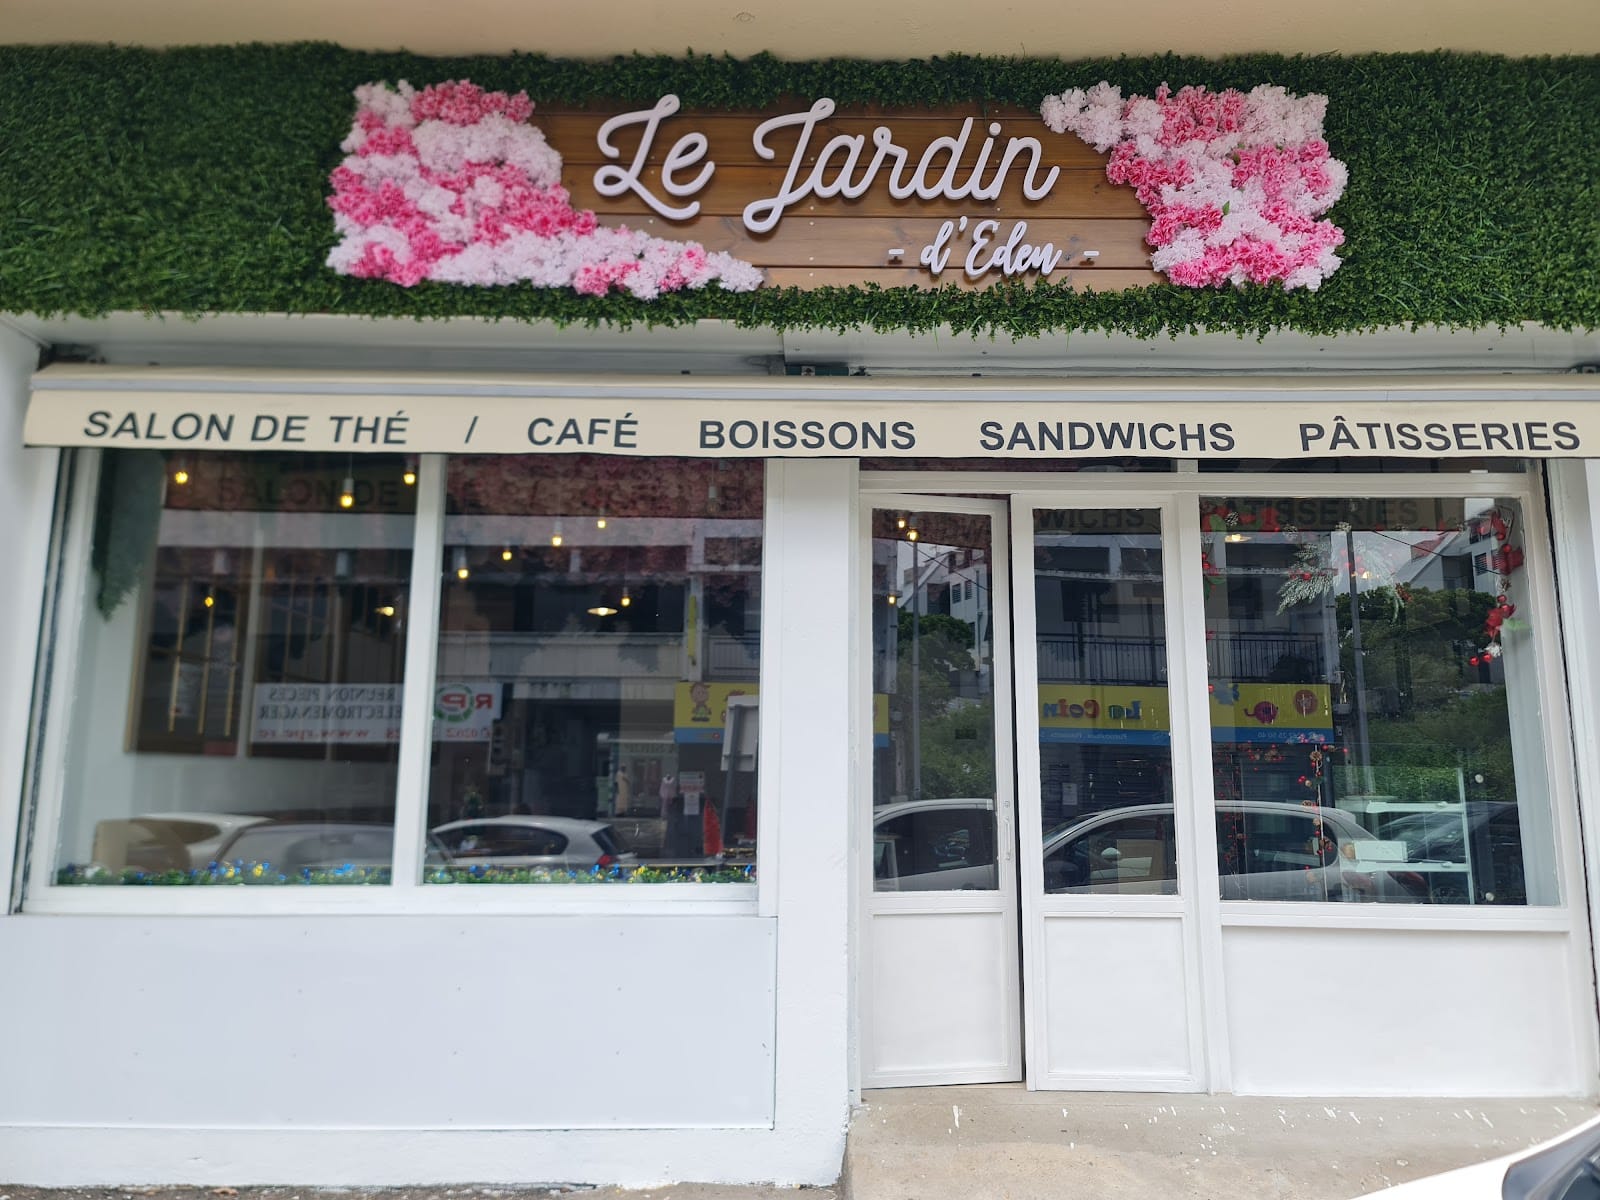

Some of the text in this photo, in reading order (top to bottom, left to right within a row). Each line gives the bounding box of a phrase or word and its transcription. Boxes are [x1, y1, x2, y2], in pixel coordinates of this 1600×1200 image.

[594, 94, 1061, 233] Le Jardin
[920, 216, 1063, 277] d'Eden
[83, 411, 234, 441] SALON
[250, 415, 309, 442] DE
[329, 409, 409, 444] THÉ
[527, 412, 638, 448] CAFÉ
[699, 420, 916, 450] BOISSONS
[979, 421, 1235, 453] SANDWICHS
[1299, 414, 1580, 453] PÂTISSERIES
